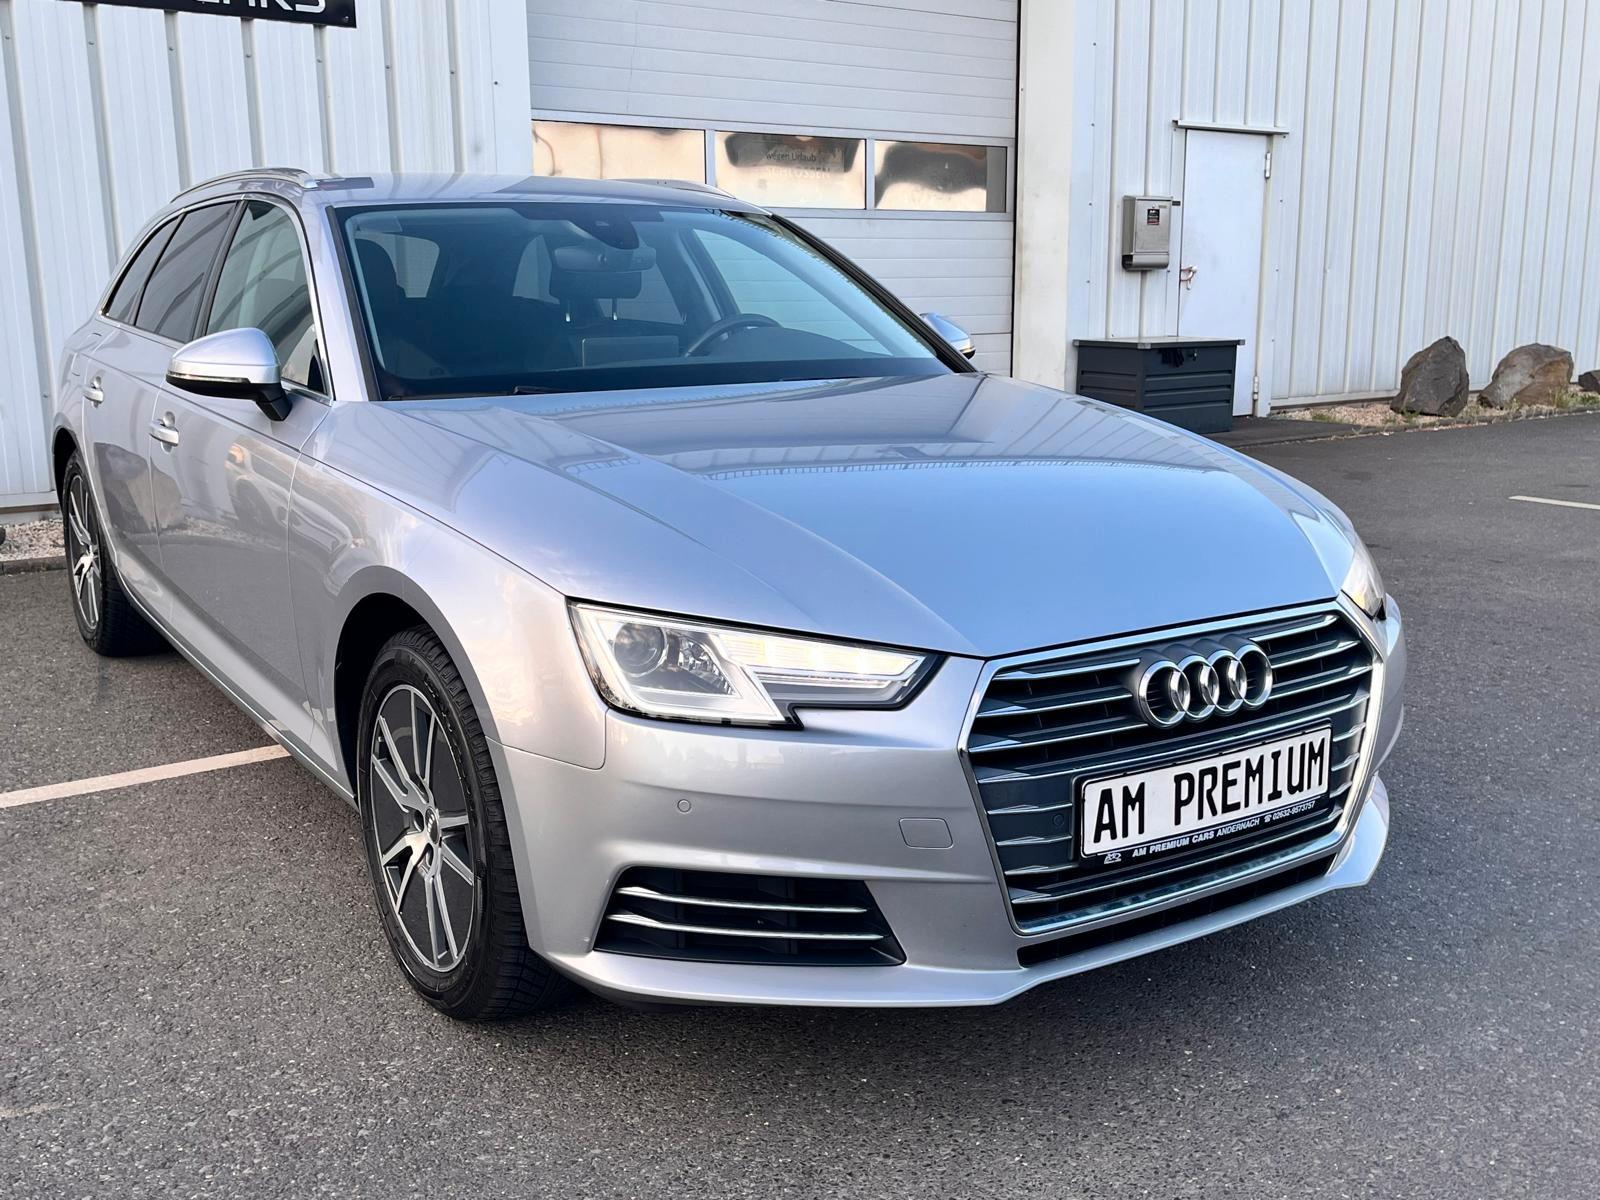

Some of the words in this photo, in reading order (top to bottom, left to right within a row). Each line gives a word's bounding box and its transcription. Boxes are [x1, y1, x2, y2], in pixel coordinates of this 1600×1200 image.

[1093, 781, 1146, 844] AM
[1173, 737, 1326, 826] PREMIUM
[1132, 847, 1147, 858] AM
[1149, 837, 1190, 854] PREMIUM
[1191, 830, 1215, 844] CARS
[1216, 817, 1261, 837] ANDERNACH
